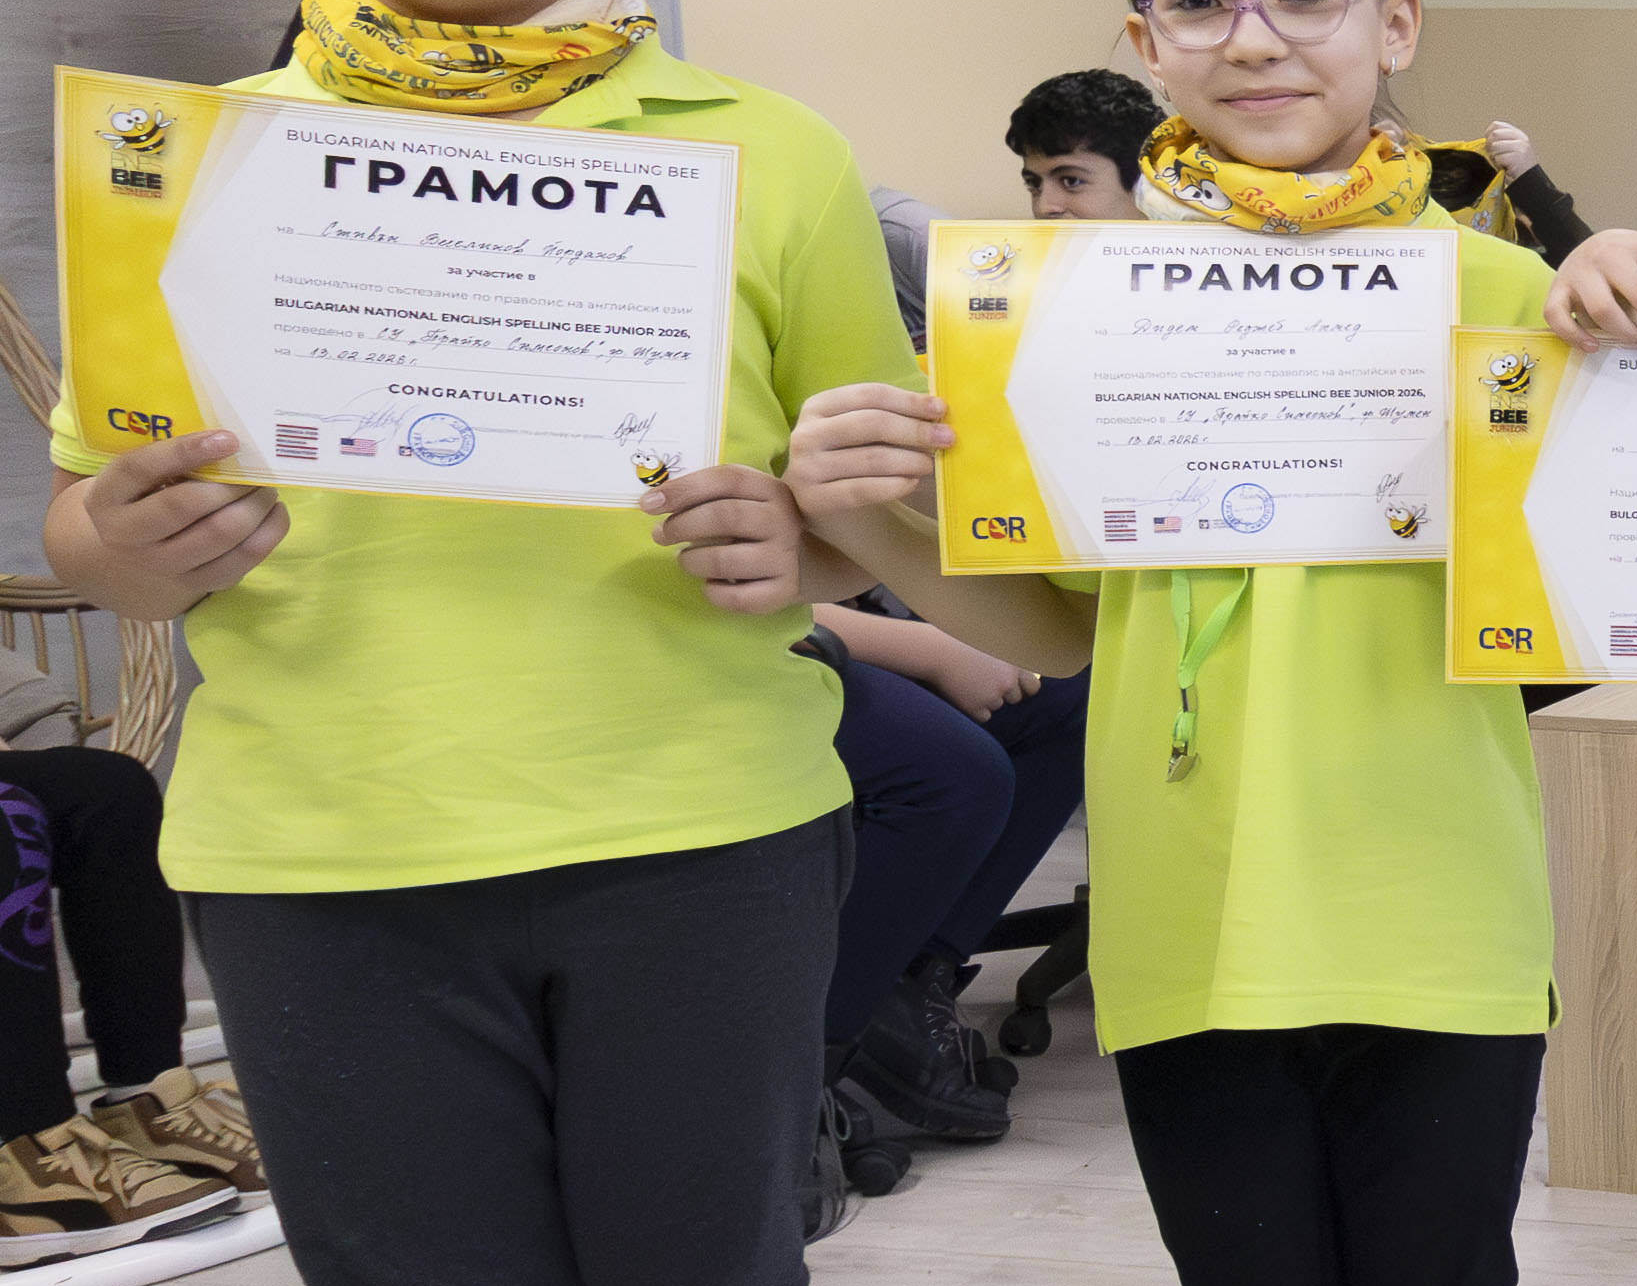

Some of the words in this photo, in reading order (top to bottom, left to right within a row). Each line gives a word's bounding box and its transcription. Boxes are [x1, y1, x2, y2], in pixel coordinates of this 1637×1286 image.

[286, 129, 394, 150] BULGARIAN
[402, 142, 494, 161] NATIONAL
[499, 151, 574, 167] ENGLISH
[581, 159, 661, 175] SPELLING
[668, 166, 698, 178] BEE
[324, 154, 665, 217] ГРАМОТА
[1102, 246, 1184, 255] BULGARIAN
[1189, 246, 1261, 257] NATIONAL
[1265, 247, 1326, 258] ENGLISH
[1329, 247, 1394, 257] SPELLING
[1399, 248, 1424, 257] BEE
[1131, 263, 1397, 290] ГРАМОТА
[387, 383, 583, 407] CONGRATULATIONS!
[1186, 458, 1341, 470] CONGRATULATIONS!
